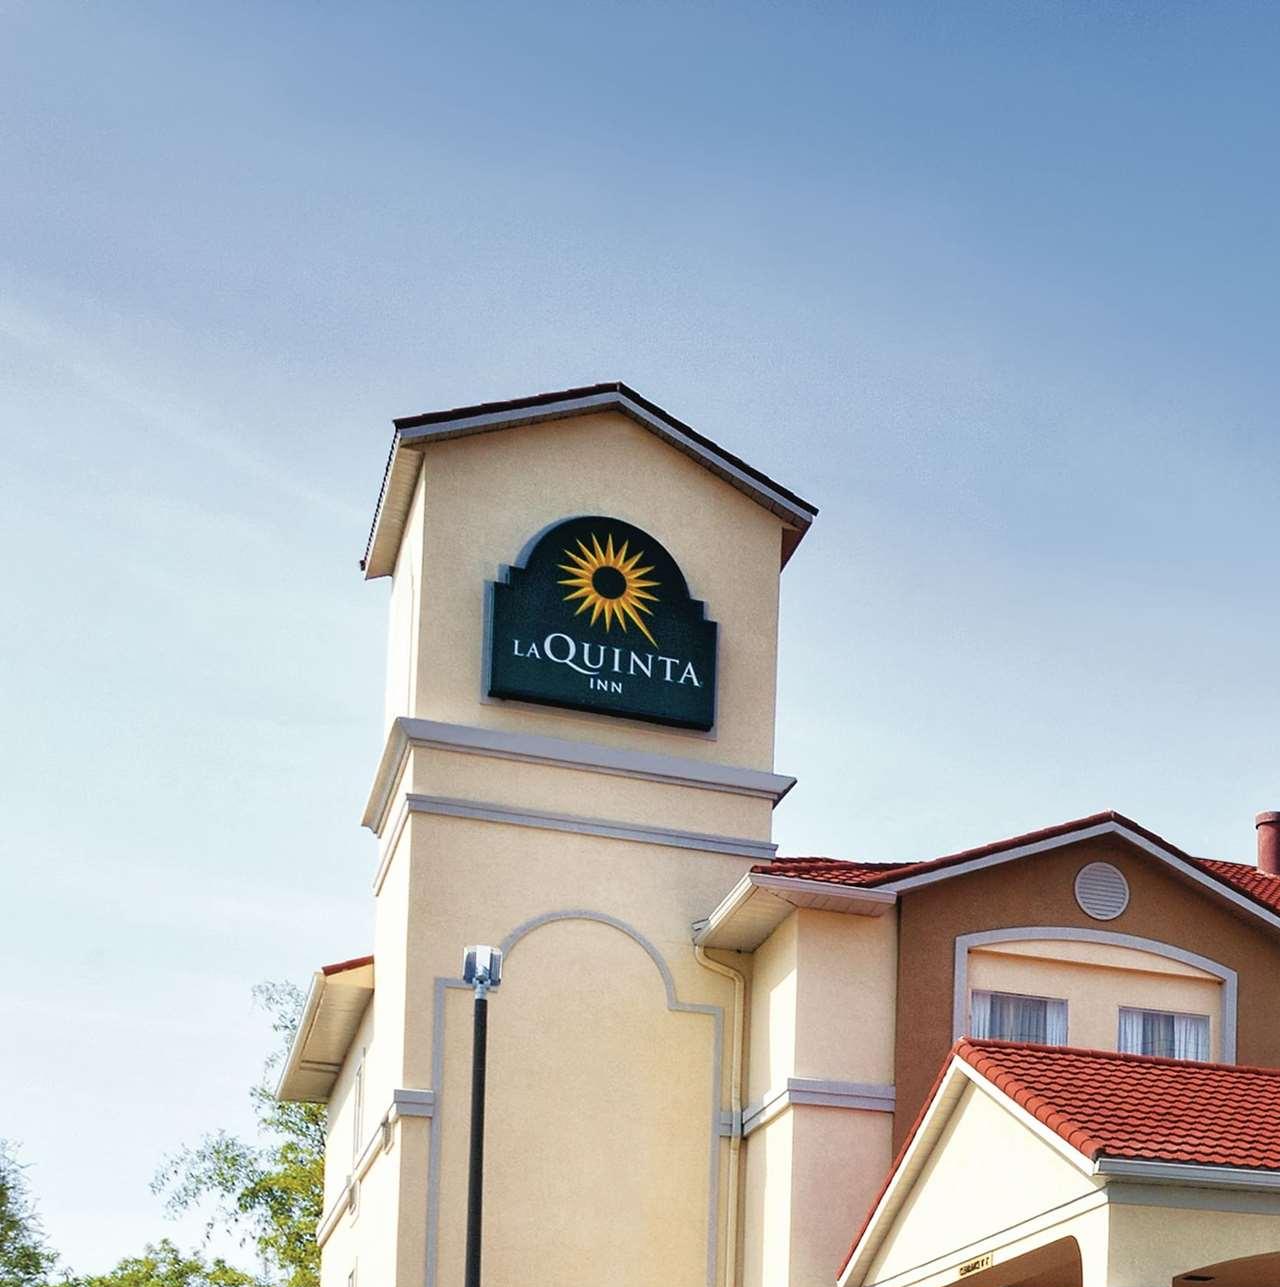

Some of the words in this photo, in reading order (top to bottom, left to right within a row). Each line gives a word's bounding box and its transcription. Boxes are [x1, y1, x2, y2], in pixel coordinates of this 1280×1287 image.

[513, 639, 541, 659] LA
[544, 633, 701, 687] QUINTA
[589, 678, 622, 693] INN
